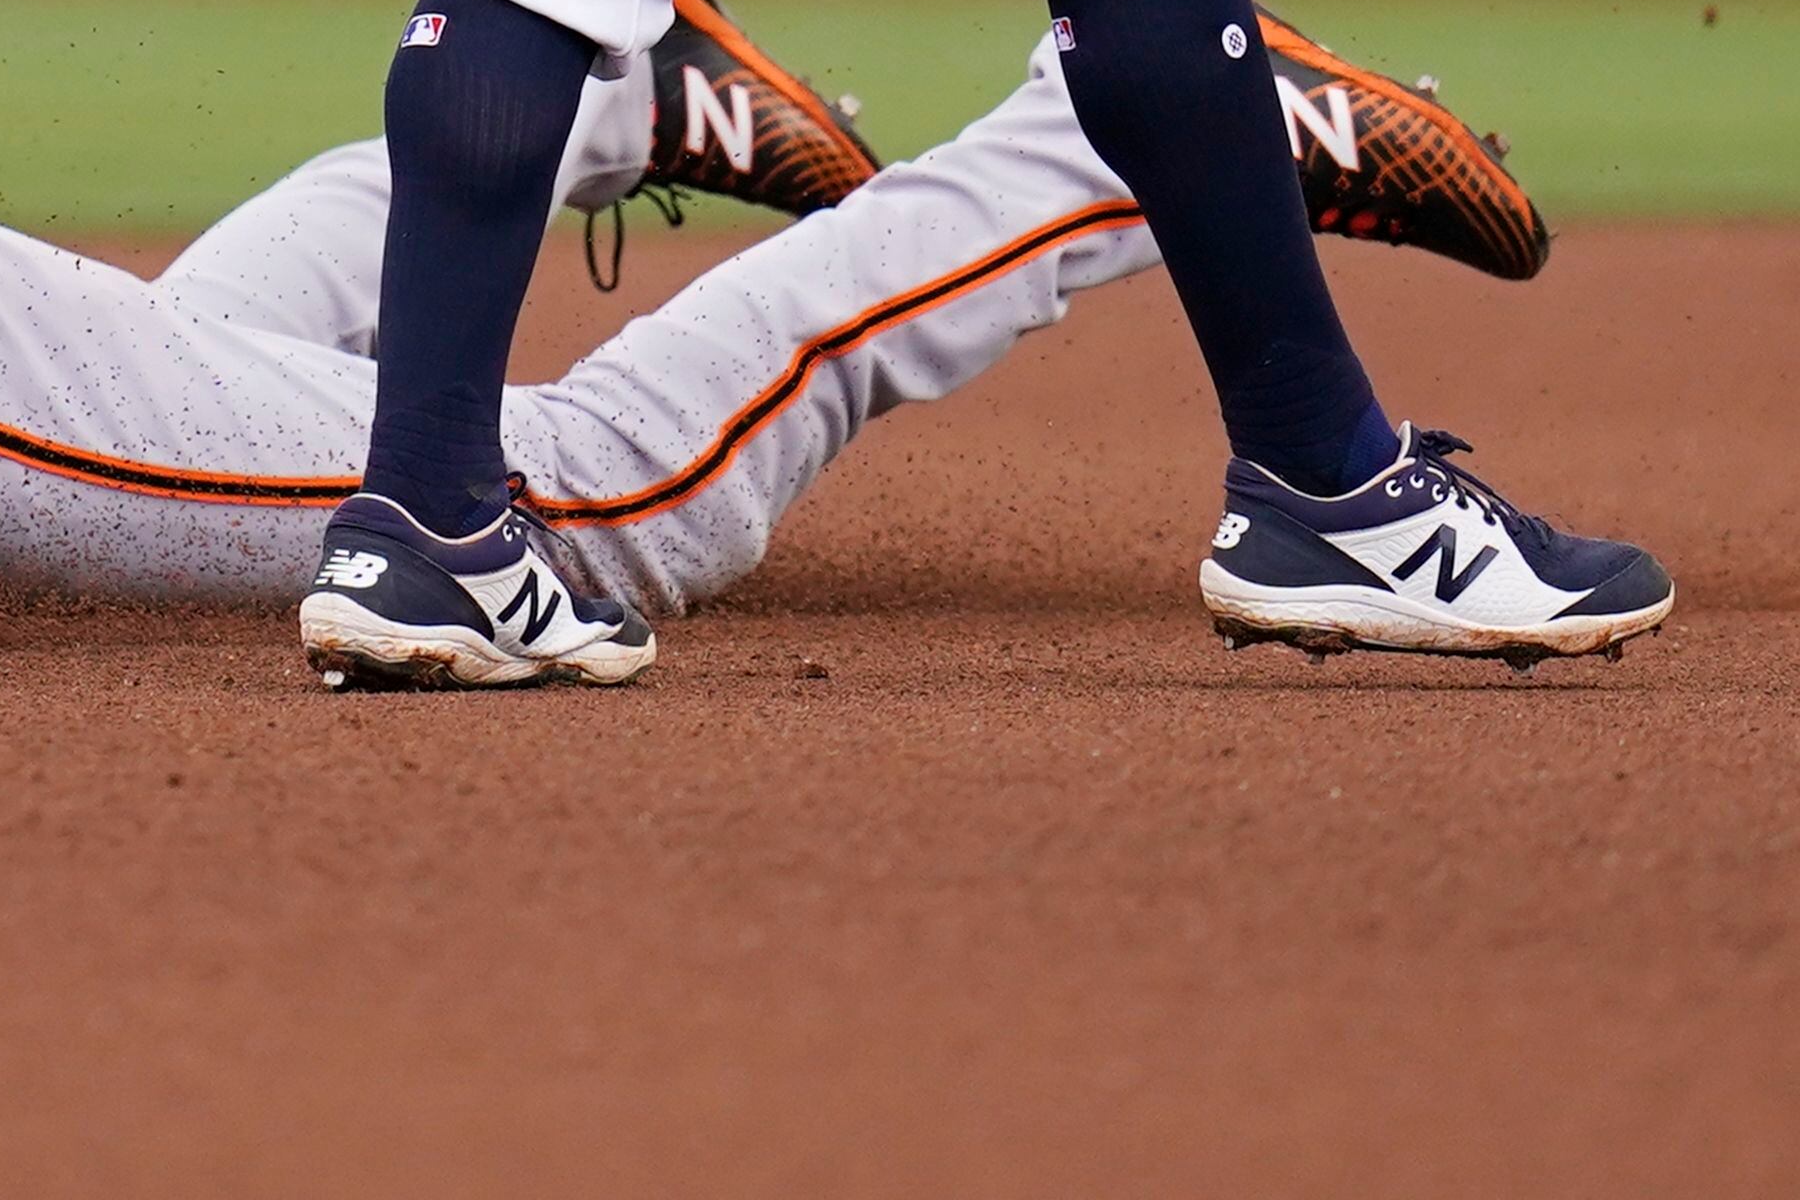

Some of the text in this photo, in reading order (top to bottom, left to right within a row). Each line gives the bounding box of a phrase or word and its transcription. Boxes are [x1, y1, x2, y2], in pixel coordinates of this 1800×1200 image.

[682, 63, 752, 174] N
[1273, 74, 1361, 173] N
[497, 567, 562, 646] N
[1391, 523, 1500, 604] N
